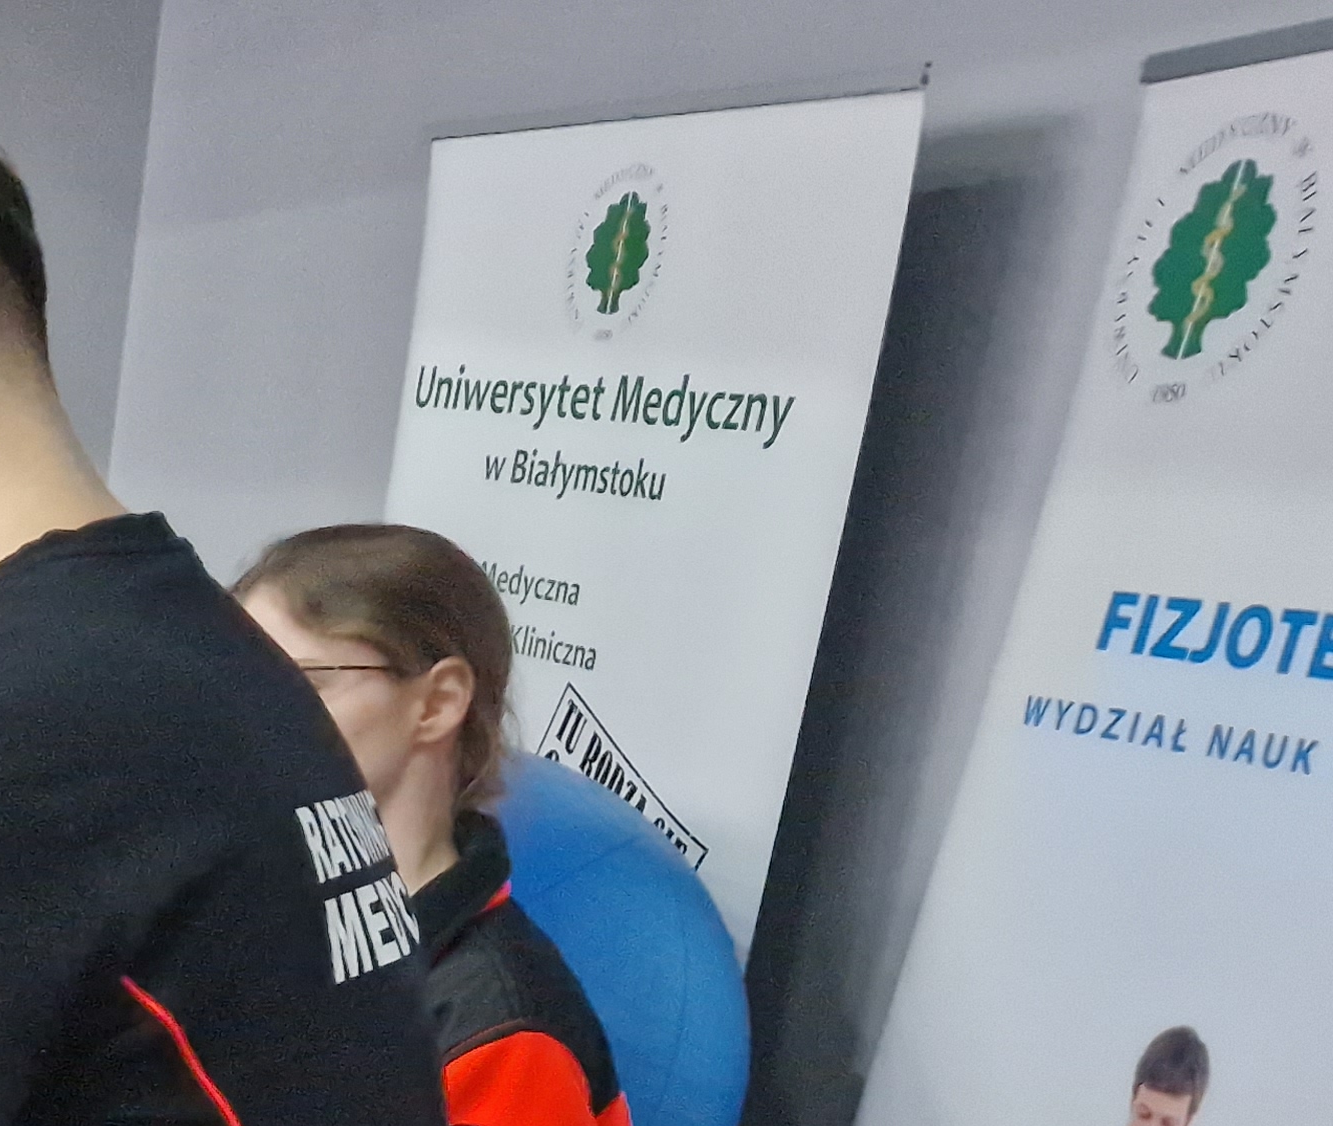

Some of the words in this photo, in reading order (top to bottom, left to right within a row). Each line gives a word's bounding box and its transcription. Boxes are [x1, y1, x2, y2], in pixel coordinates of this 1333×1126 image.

[415, 364, 606, 430] Uniwersytet
[610, 374, 796, 450] Medyczny
[485, 455, 506, 481] w
[510, 448, 667, 501] Białymstoku
[556, 699, 587, 755] TU
[1023, 695, 1187, 753] WYDZIAŁ
[1206, 724, 1319, 775] NAUK
